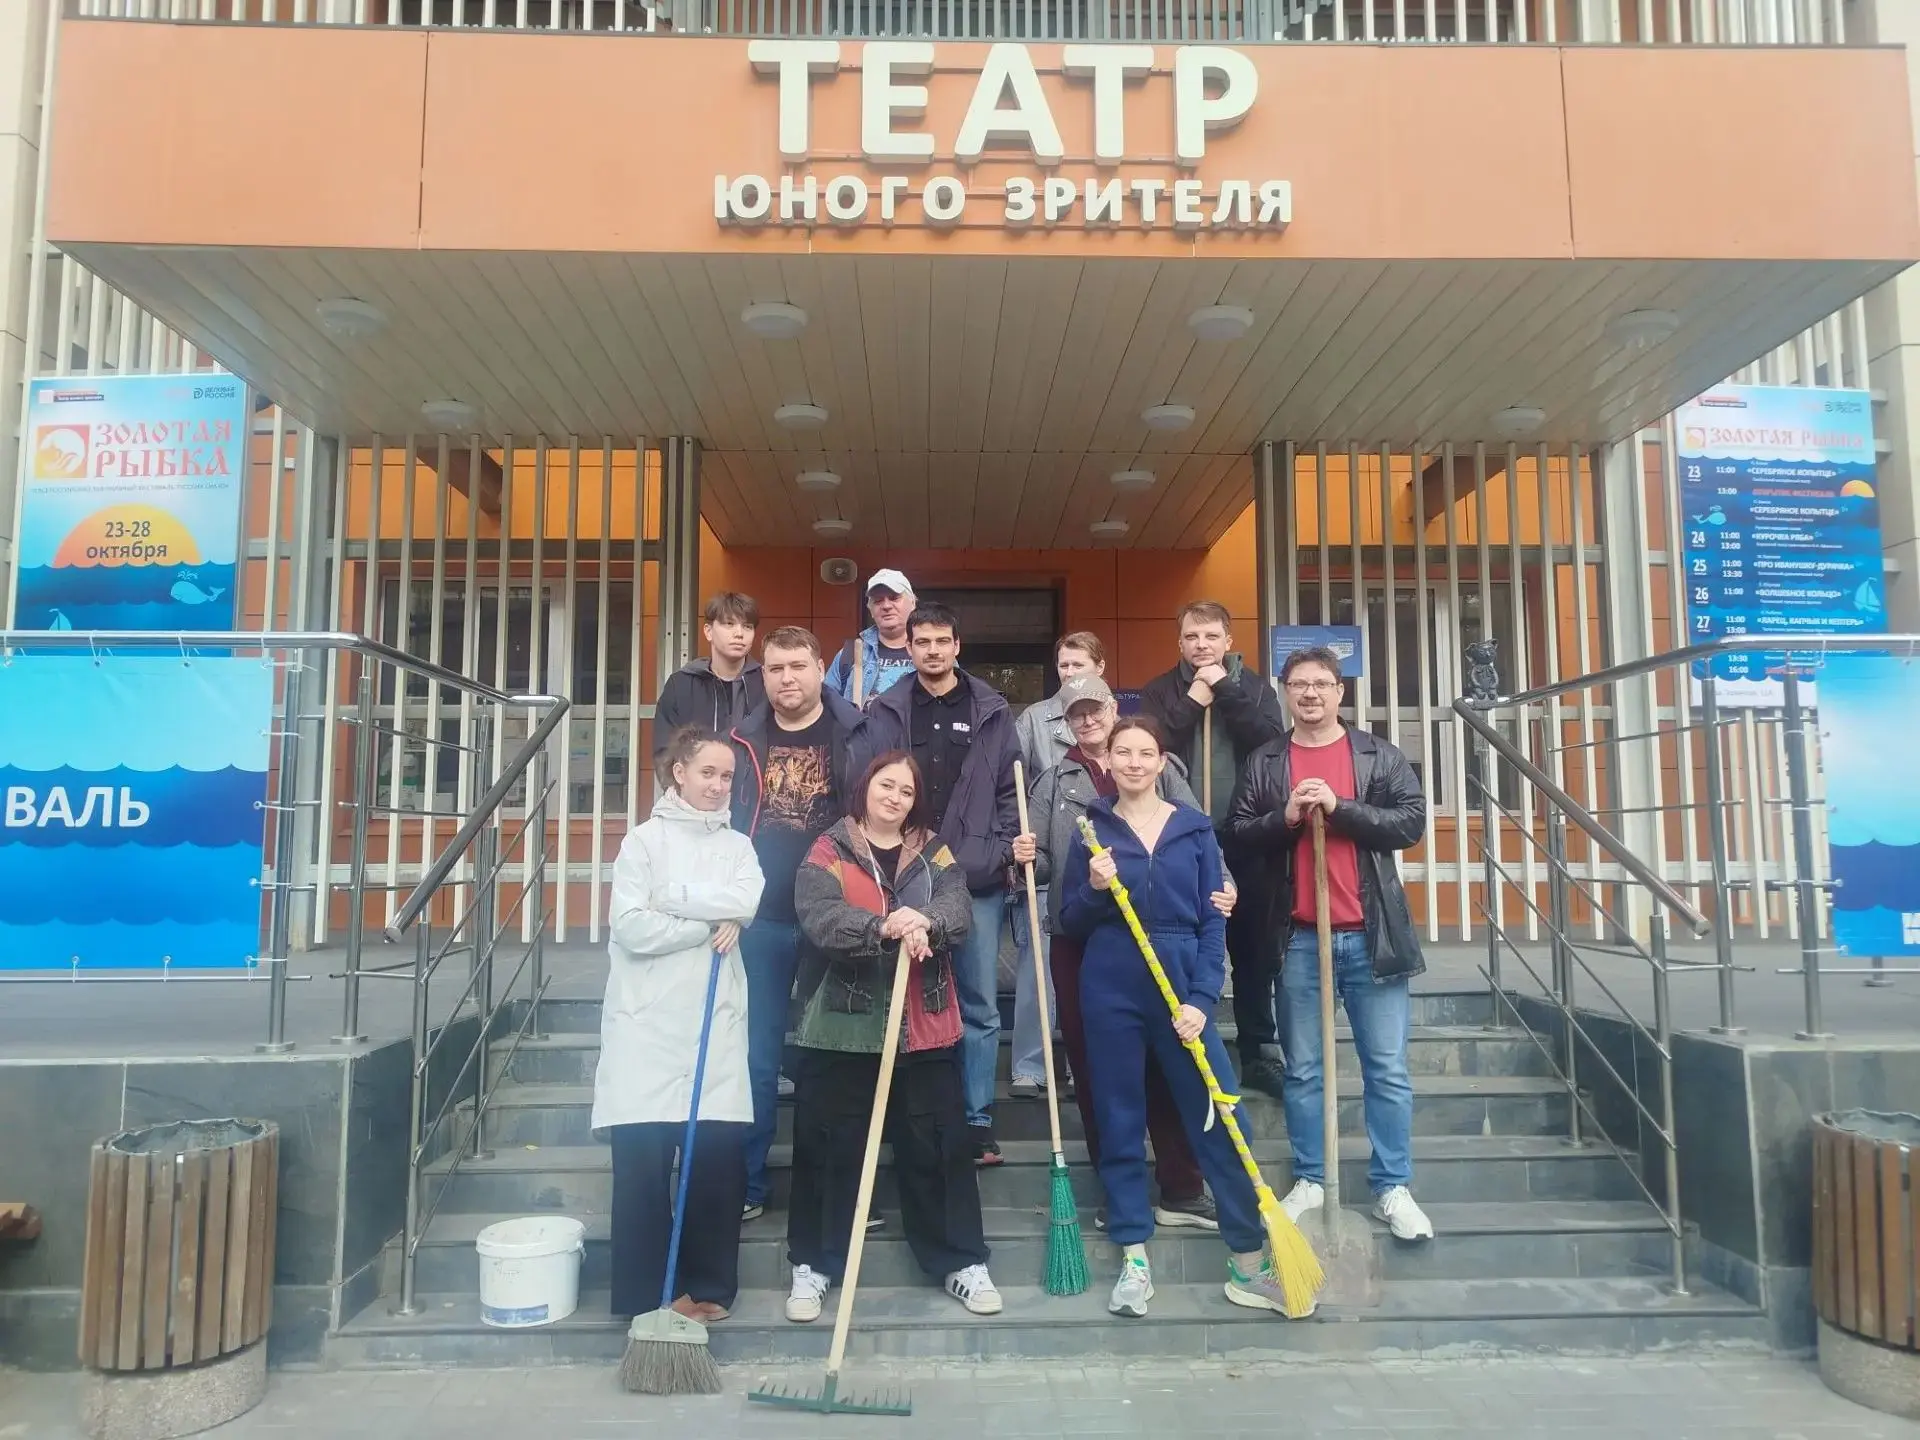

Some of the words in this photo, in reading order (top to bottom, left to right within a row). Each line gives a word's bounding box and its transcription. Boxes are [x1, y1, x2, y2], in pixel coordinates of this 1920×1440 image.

[747, 40, 1259, 165] ТЕАТР
[714, 174, 966, 224] ЮНОГО
[1004, 176, 1293, 227] ЗРИТЕЛЯ
[204, 391, 235, 399] РОССИЯ
[95, 419, 232, 448] ЗОЛОТАЯ
[1710, 427, 1792, 445] ЗОЛОТАЯ
[95, 447, 232, 478] РЫБКА
[1687, 465, 1701, 478] 23
[1716, 466, 1736, 474] 11:00
[104, 521, 151, 538] 23-28
[1691, 531, 1706, 544] 24
[1720, 532, 1740, 540] 11:00
[86, 540, 168, 561] октября
[1693, 559, 1707, 572] 25
[1695, 587, 1709, 600] 26
[1696, 616, 1710, 629] 27
[5, 786, 151, 828] ВАЛЬ
